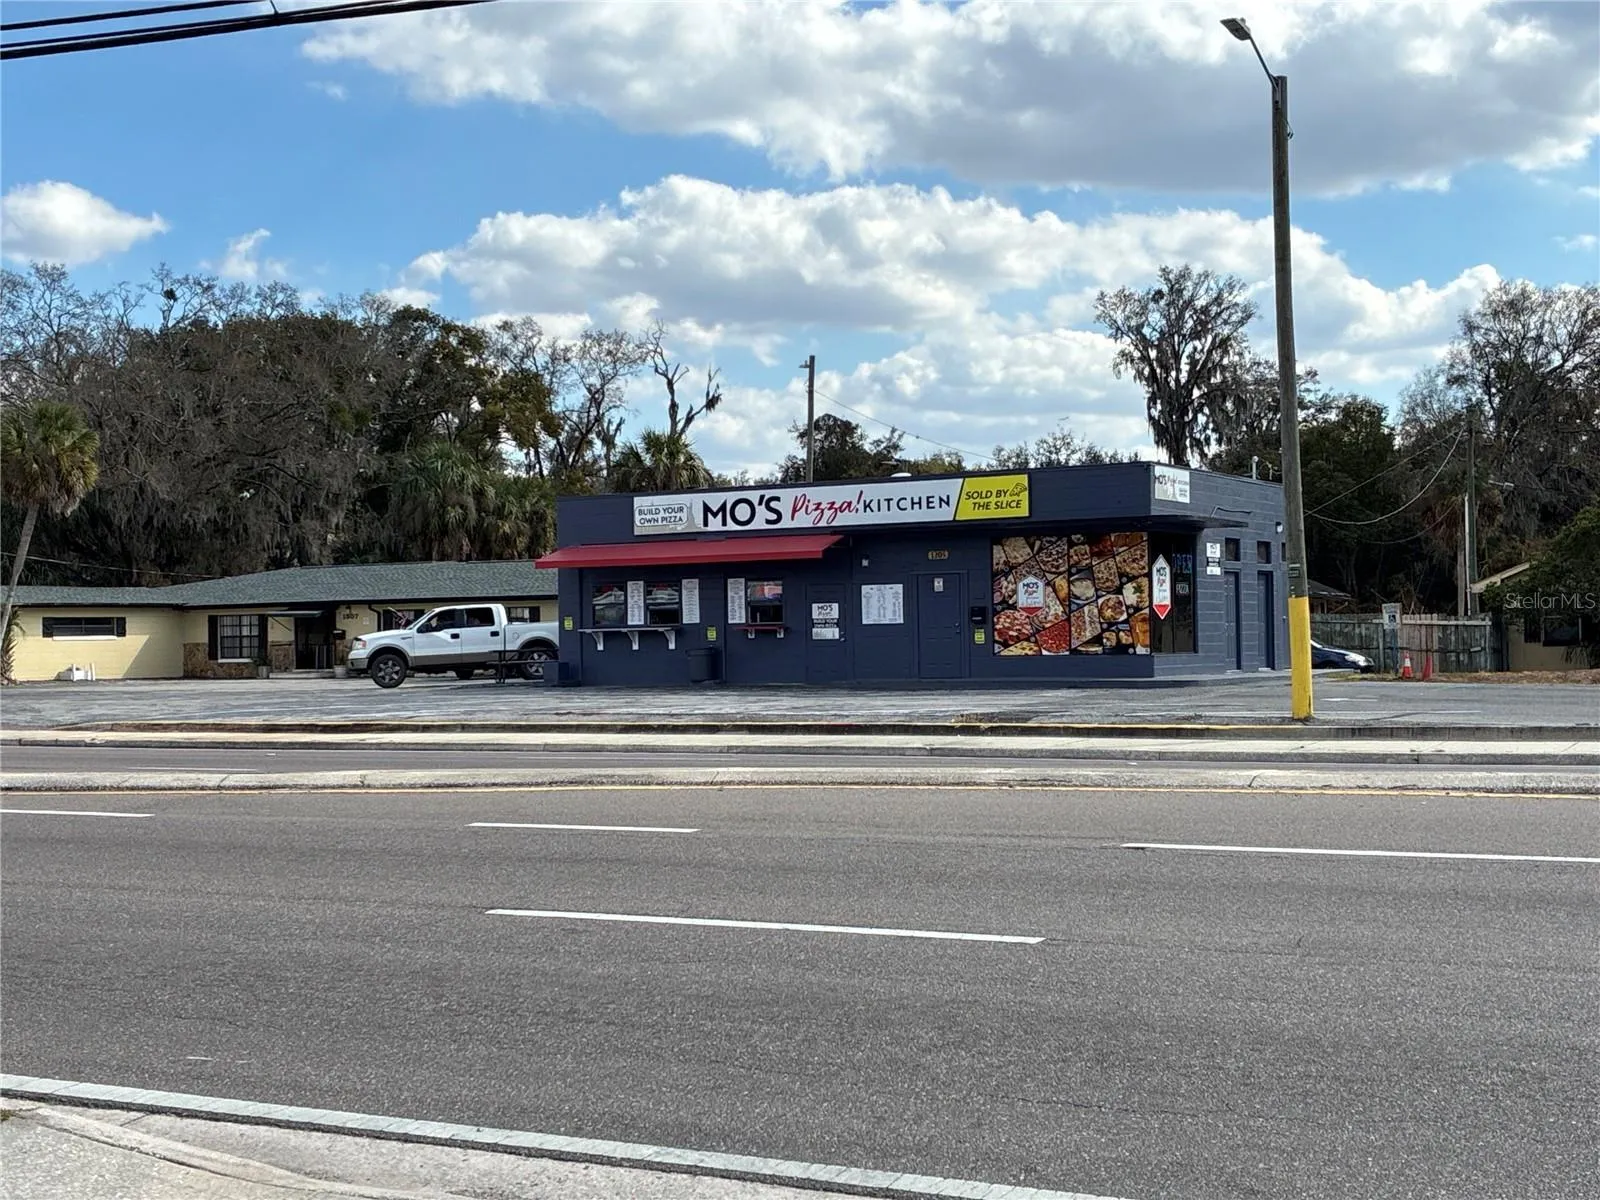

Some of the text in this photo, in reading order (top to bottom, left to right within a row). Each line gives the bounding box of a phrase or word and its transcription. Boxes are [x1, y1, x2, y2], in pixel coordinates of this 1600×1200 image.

[965, 489, 1009, 500] SOLD BY
[702, 490, 950, 528] MO'S Pizza! KITCHEN
[972, 499, 1022, 511] THE SLICE
[638, 506, 685, 516] BUILD YOUR
[639, 515, 684, 525] OWN PIZZA
